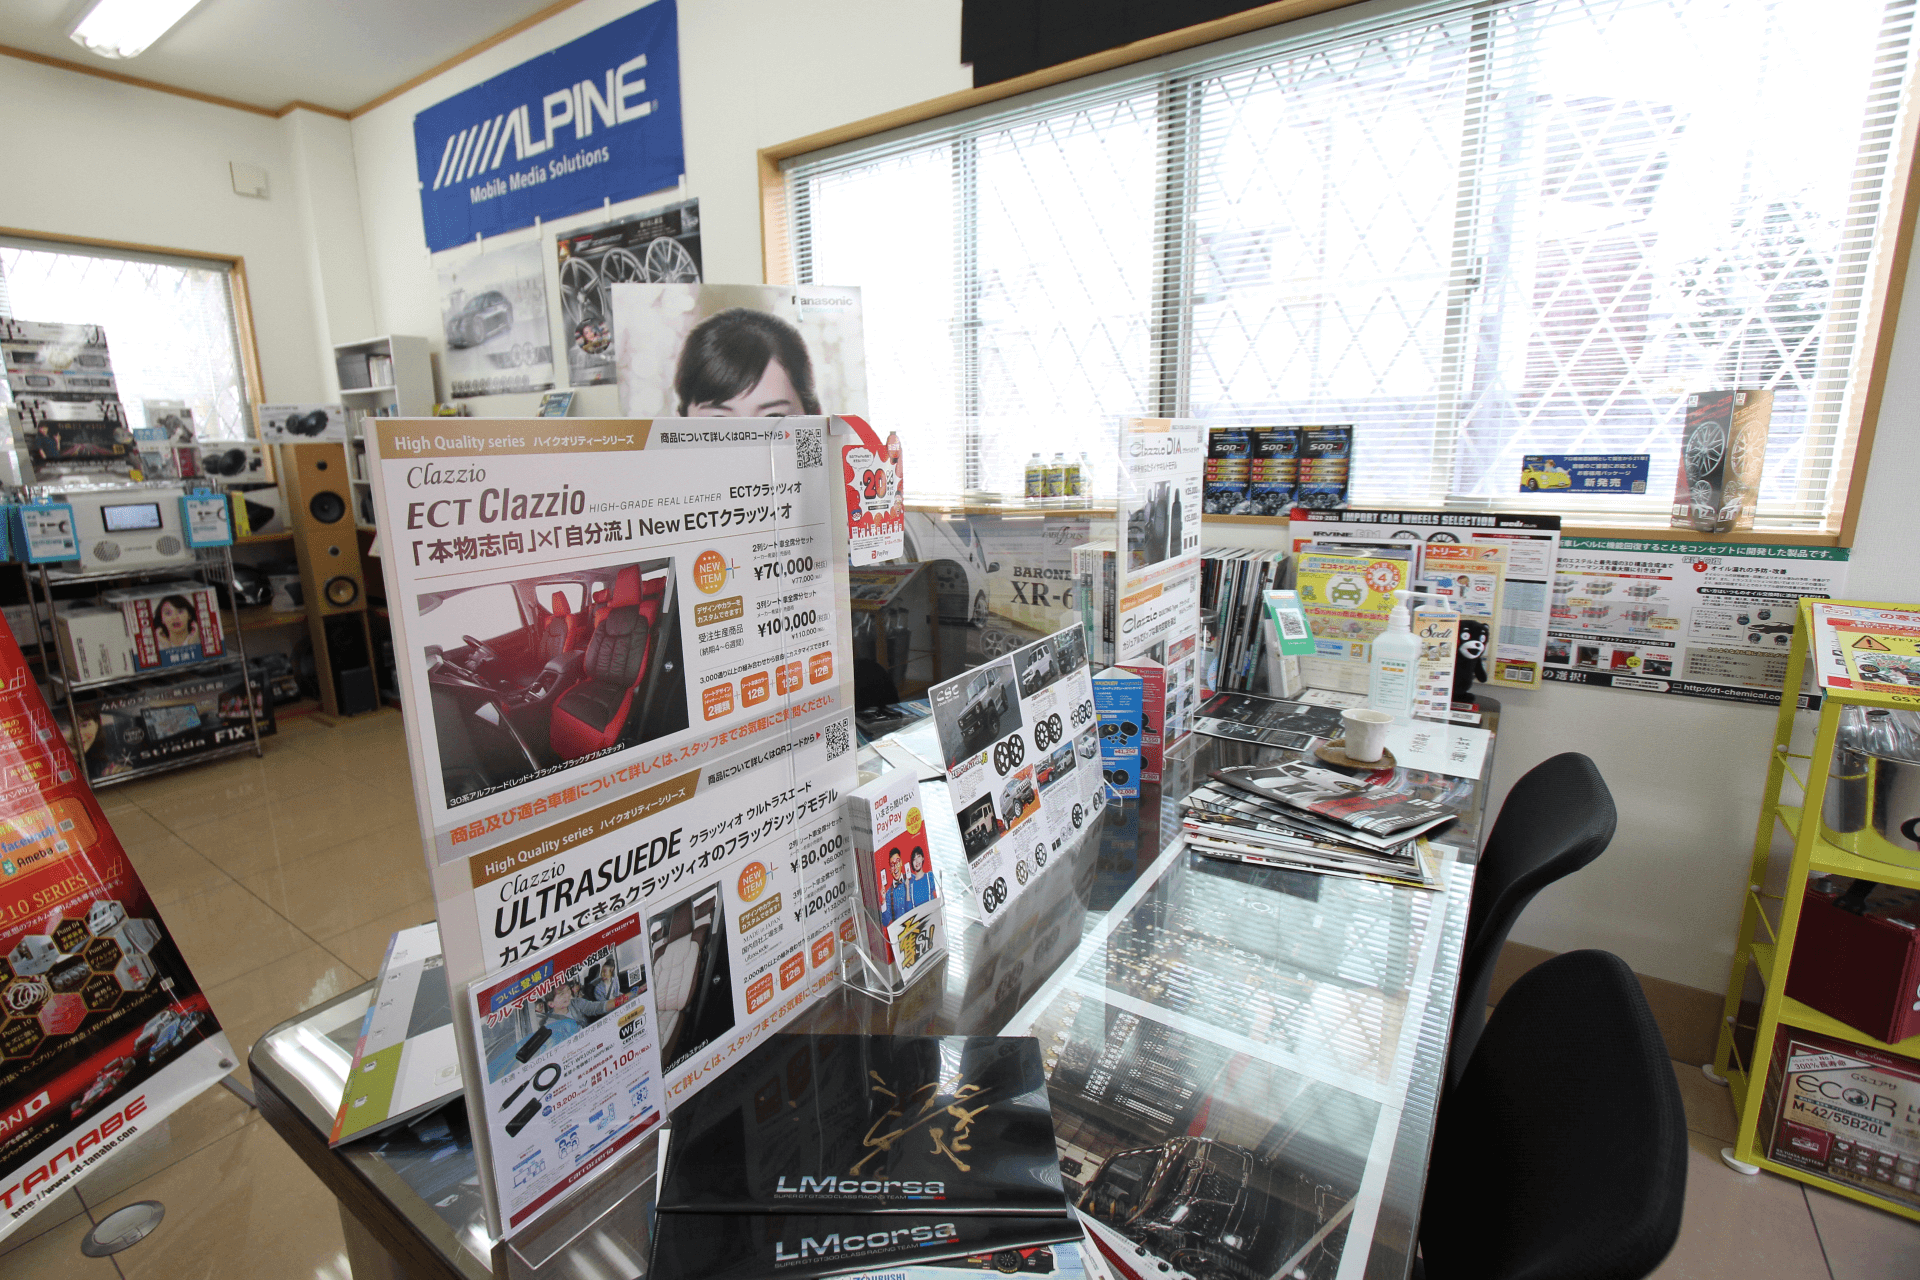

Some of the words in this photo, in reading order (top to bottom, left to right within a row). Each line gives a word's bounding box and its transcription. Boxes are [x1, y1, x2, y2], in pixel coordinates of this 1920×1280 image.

[491, 53, 652, 170] ALPINE
[470, 175, 507, 204] Mobile
[509, 165, 547, 191] Media
[549, 146, 610, 179] Solutions
[394, 435, 431, 454] High
[434, 435, 485, 452] Quality
[488, 435, 526, 449] series
[533, 434, 634, 447] ハイクオリティーシリーズ
[406, 462, 487, 489] Clazzio
[1584, 478, 1622, 488] 新発売
[729, 480, 802, 499] ECTクラッツィオ
[407, 498, 473, 530] ECT
[478, 484, 586, 524] Clazzio
[589, 498, 654, 513] HIGH-GRADE
[657, 496, 681, 507] REAL
[683, 492, 722, 504] LEATHER
[639, 517, 681, 537] New
[683, 502, 793, 531] ECTクラッツィオ
[1341, 512, 1379, 523] IMPORT
[1381, 513, 1400, 524] CAR
[1402, 514, 1440, 525] WHEELS
[1441, 514, 1497, 527] SELECTION
[1313, 530, 1353, 538] IRVINE
[699, 562, 721, 573] NEW
[700, 574, 722, 585] ITEM
[753, 555, 813, 581] ¥70,000
[698, 623, 744, 644] 受注生産商品
[757, 609, 817, 638] ¥100,000
[814, 665, 829, 678] 12色
[747, 686, 765, 701] 12色
[600, 787, 685, 830] ハイクオリティーシリーズ
[689, 812, 744, 848] クラッツィオ
[746, 780, 812, 820] ウルトラスエード
[876, 811, 903, 836] PayPay
[1, 824, 58, 854] facebook
[485, 857, 515, 876] High
[517, 838, 560, 862] Quality
[562, 826, 594, 845] series
[16, 846, 54, 868] Ameba
[494, 827, 683, 939] ULTRASUEDE
[500, 861, 566, 902] Clazzio
[741, 870, 762, 885] NEW
[743, 878, 763, 896] ITEM
[33, 872, 89, 909] SERIES
[2, 1023, 21, 1038] Point
[22, 1019, 32, 1028] 10
[602, 1049, 634, 1078] 1,100
[1792, 1099, 1887, 1138] M-42/55B20L
[0, 1094, 148, 1210] TANABE
[776, 1175, 945, 1194] LMcorsa
[775, 1222, 957, 1262] LMcorsa
